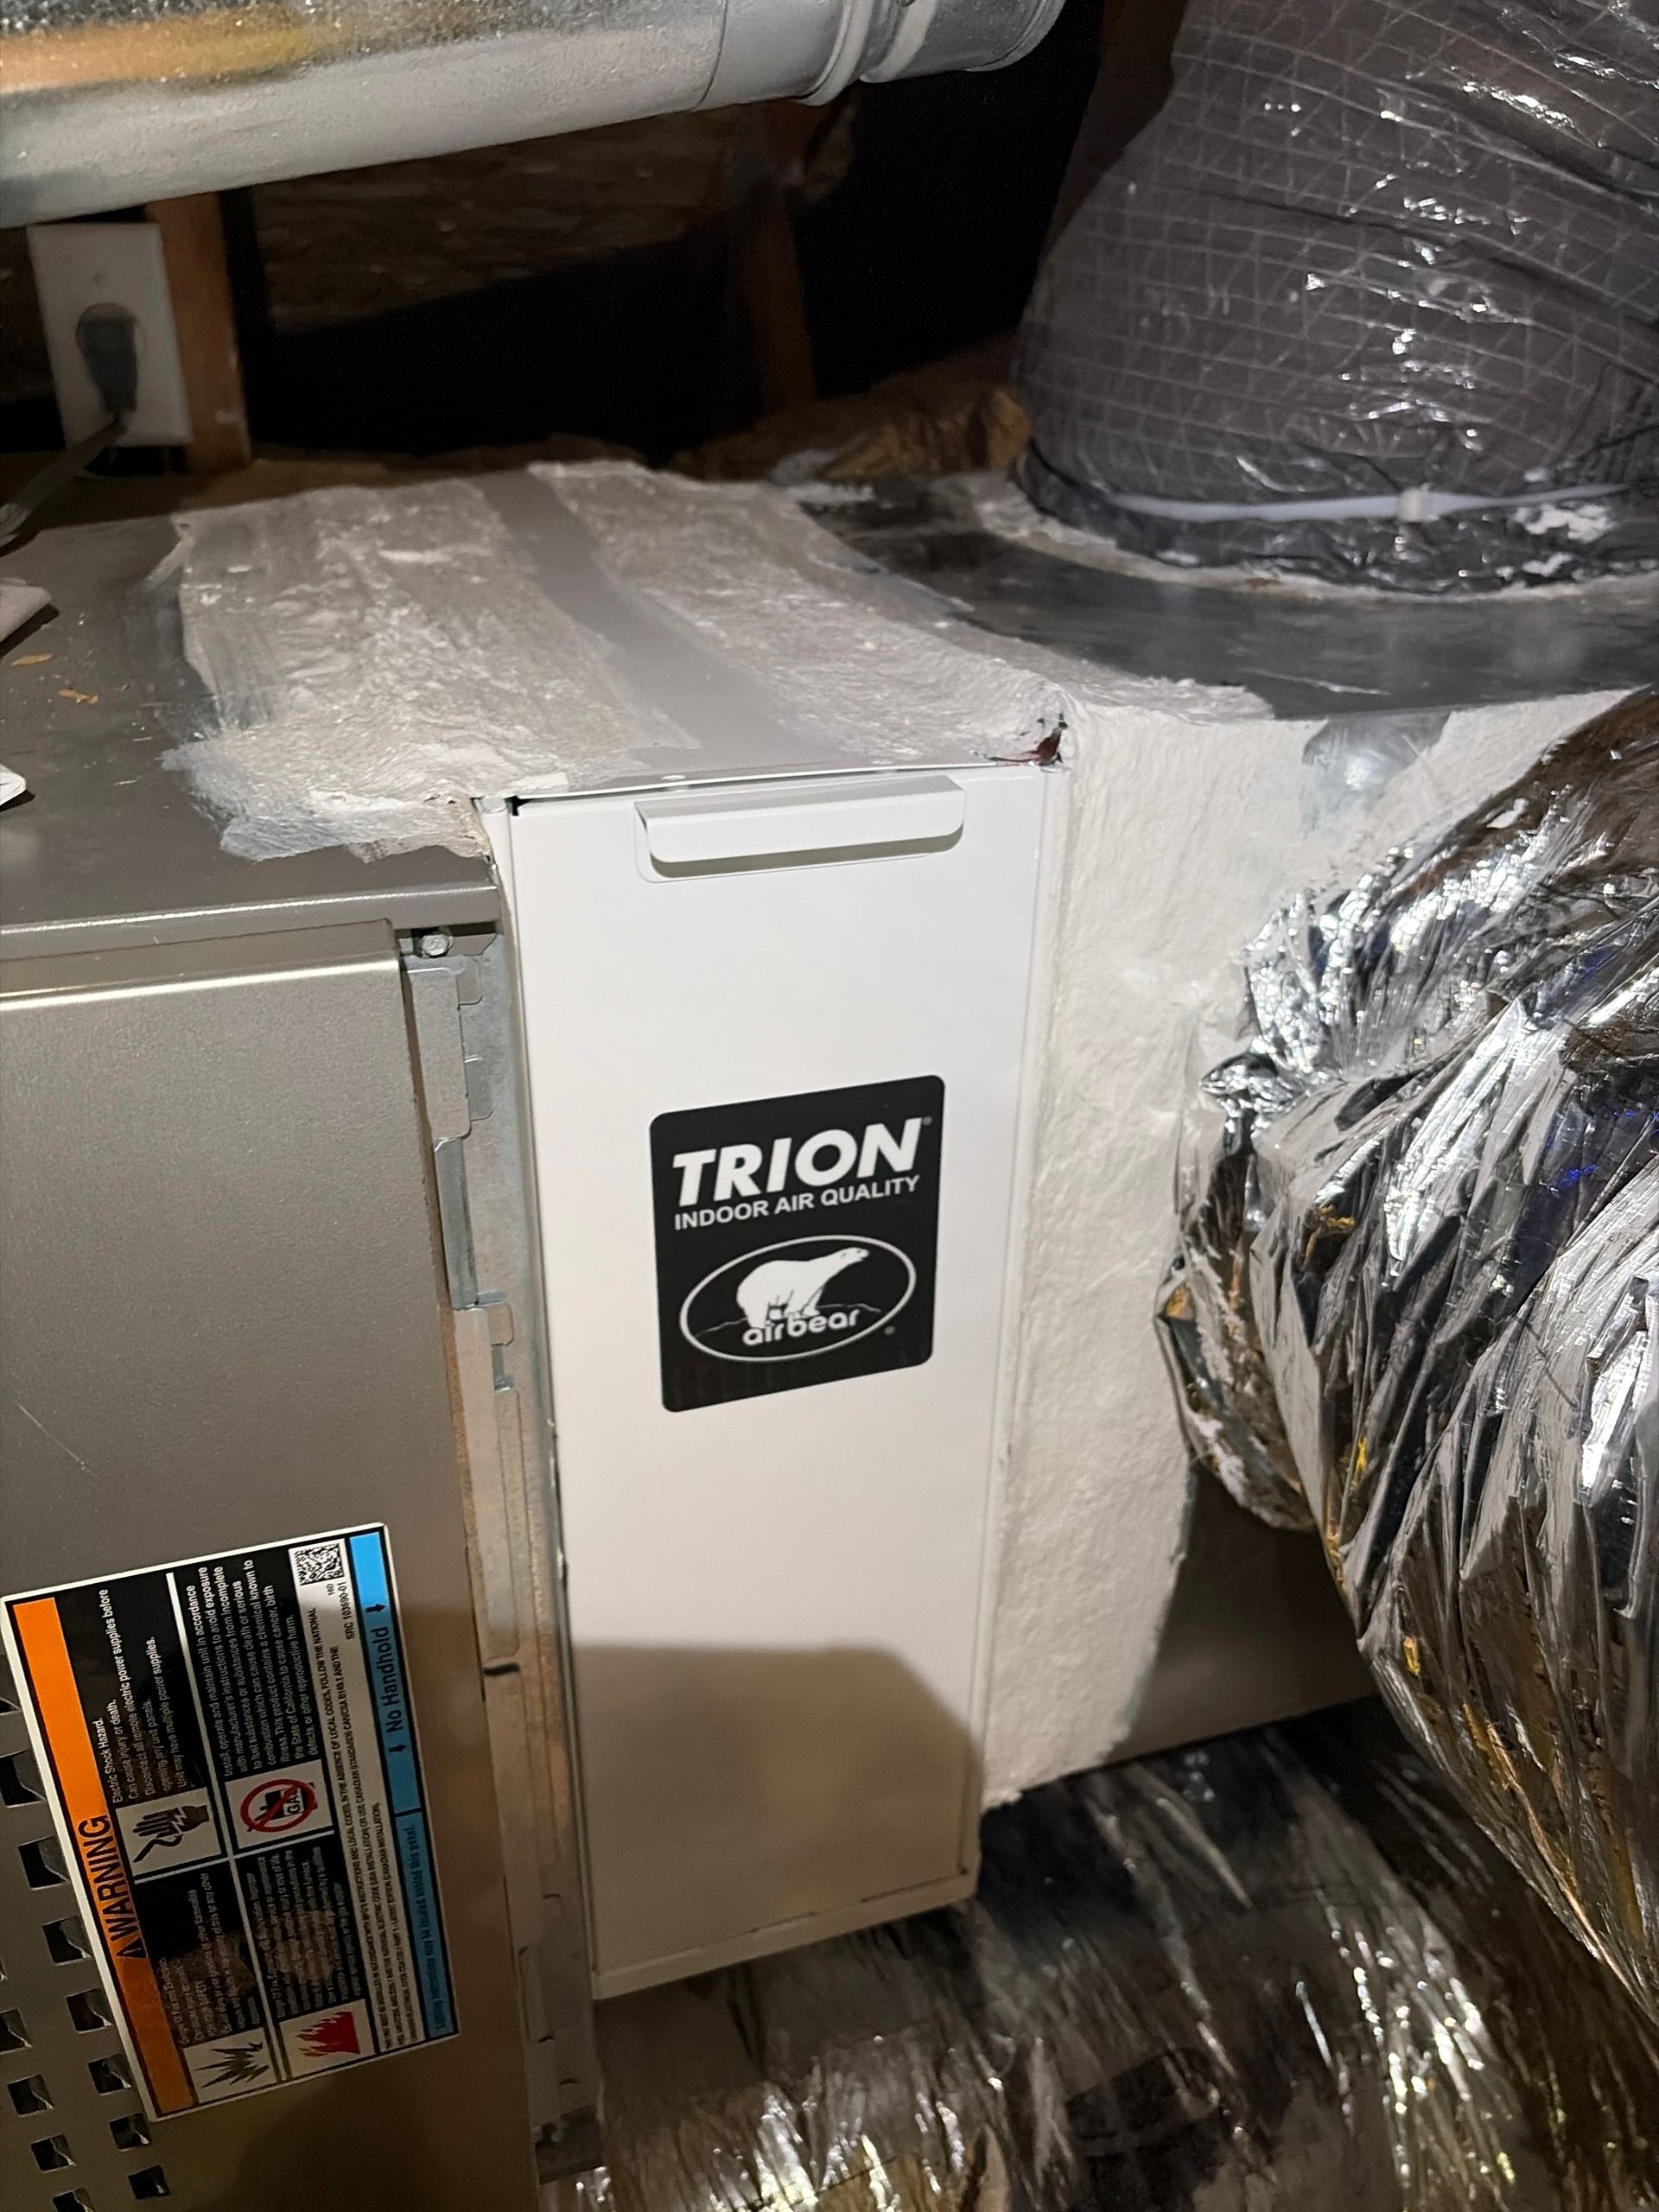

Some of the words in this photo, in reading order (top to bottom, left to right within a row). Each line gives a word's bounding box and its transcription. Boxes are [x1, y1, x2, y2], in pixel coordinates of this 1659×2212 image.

[673, 1117, 922, 1207] TRION
[675, 1200, 768, 1230] INDOOR
[775, 1192, 815, 1214] AIR
[821, 1175, 920, 1207] QUALITY
[742, 1309, 860, 1345] airbear
[244, 1559, 254, 1569] to
[198, 1566, 217, 1608] exposure
[211, 1565, 234, 1615] incomplete
[231, 1580, 247, 1613] serious
[245, 1570, 260, 1599] known
[263, 1585, 276, 1606] birth
[95, 1588, 113, 1618] before
[184, 1584, 205, 1636] accordance
[205, 1609, 219, 1633] avoid
[222, 1616, 236, 1637] from
[250, 1600, 267, 1640] chemical
[307, 1607, 321, 1644] NATIONAL
[343, 1621, 355, 1639] SRC
[103, 1617, 124, 1654] supplies
[195, 1637, 207, 1646] in
[210, 1634, 221, 1643] to
[239, 1625, 253, 1649] death
[143, 1636, 164, 1675] supplies.
[197, 1646, 210, 1664] unit
[314, 1644, 324, 1659] THE
[371, 1625, 399, 1706] Handhold
[114, 1654, 130, 1681] power
[316, 1659, 329, 1688] FOLLOW
[118, 1681, 136, 1712] electric
[105, 1699, 122, 1725] death.
[383, 1708, 403, 1732] No
[92, 1717, 110, 1748] Hazard.
[326, 1716, 338, 1739] LOCAL
[99, 1748, 116, 1773] Shock
[106, 1774, 124, 1803] Electric
[76, 1814, 140, 1942] WARNING
